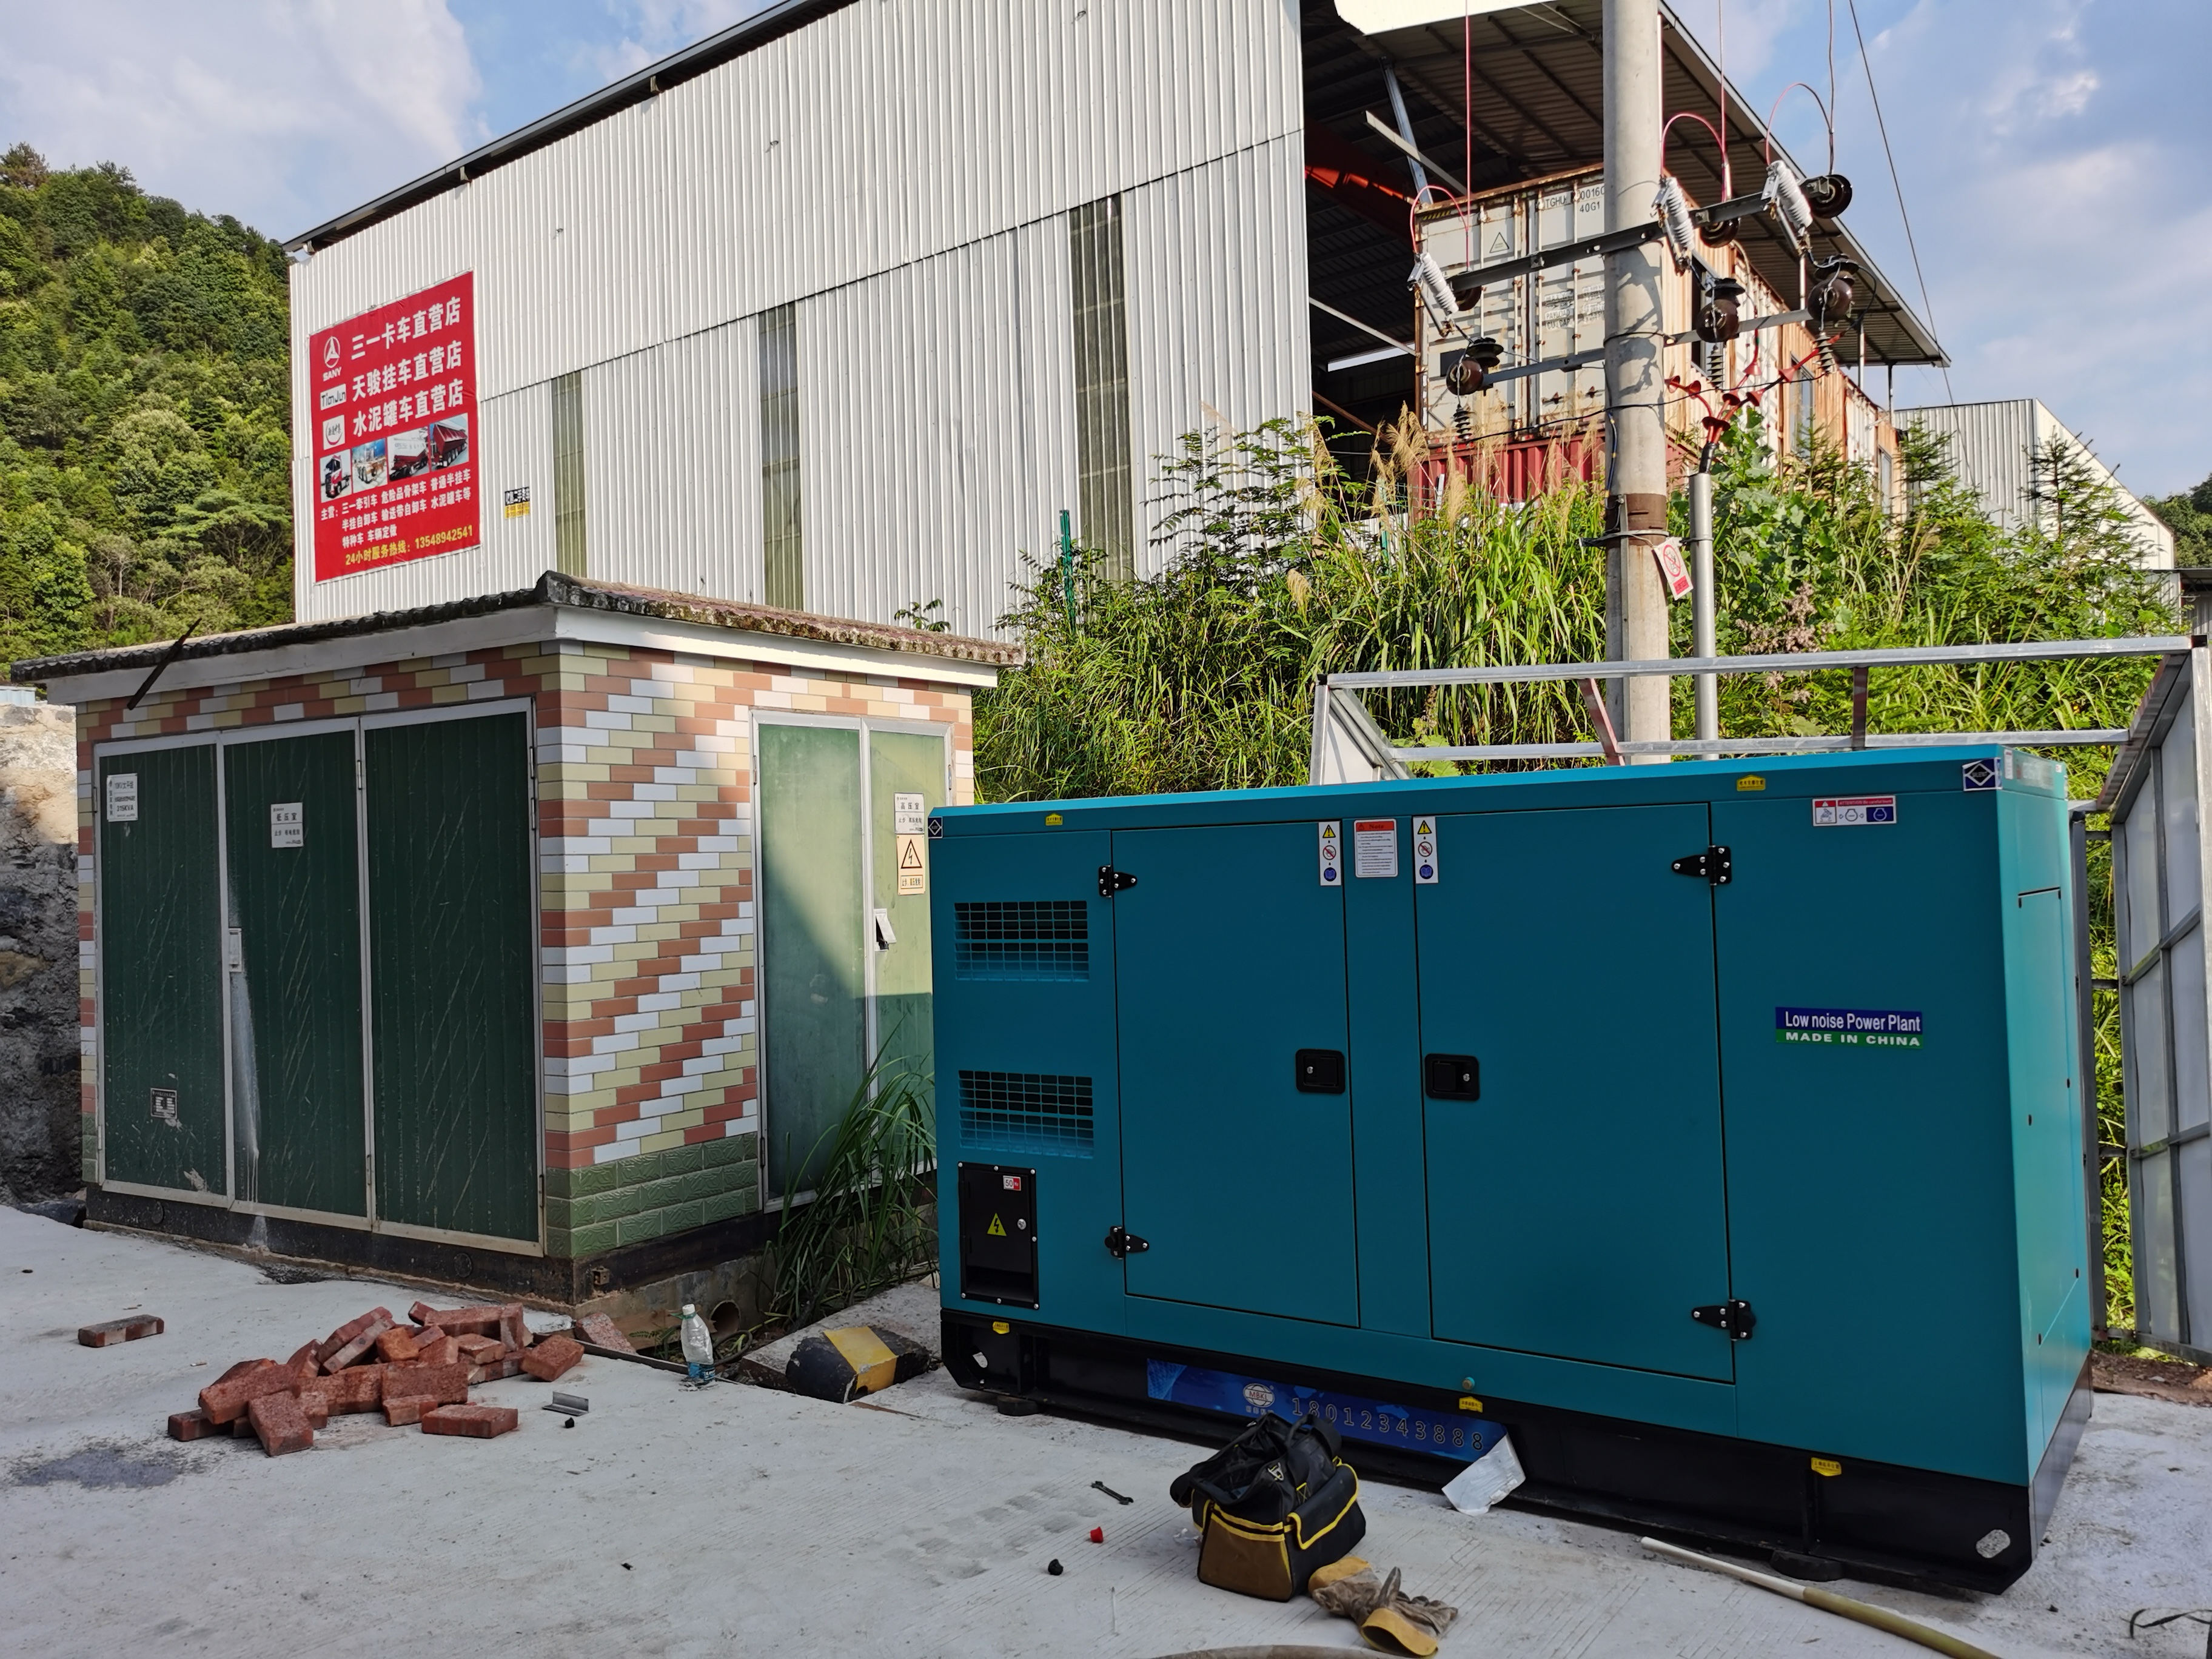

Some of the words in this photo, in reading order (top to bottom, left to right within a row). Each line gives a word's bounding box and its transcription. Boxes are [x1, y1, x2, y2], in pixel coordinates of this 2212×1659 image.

[1580, 201, 1600, 213] 40G1
[351, 296, 461, 360] 三一卡车直营店
[323, 367, 342, 382] SANY
[352, 340, 462, 402] 天骏挂车直营店
[353, 378, 463, 437] 水泥罐车直营店
[415, 524, 473, 549] 13548942541
[900, 802, 920, 810] 高压室
[1785, 1011, 1809, 1028] Low
[1812, 1013, 1844, 1028] noise
[1847, 1013, 1886, 1030] Power
[1888, 1014, 1921, 1032] Plant
[1786, 1032, 1832, 1042] MADE
[1840, 1034, 1858, 1044] IN
[1866, 1036, 1920, 1047] CHINA
